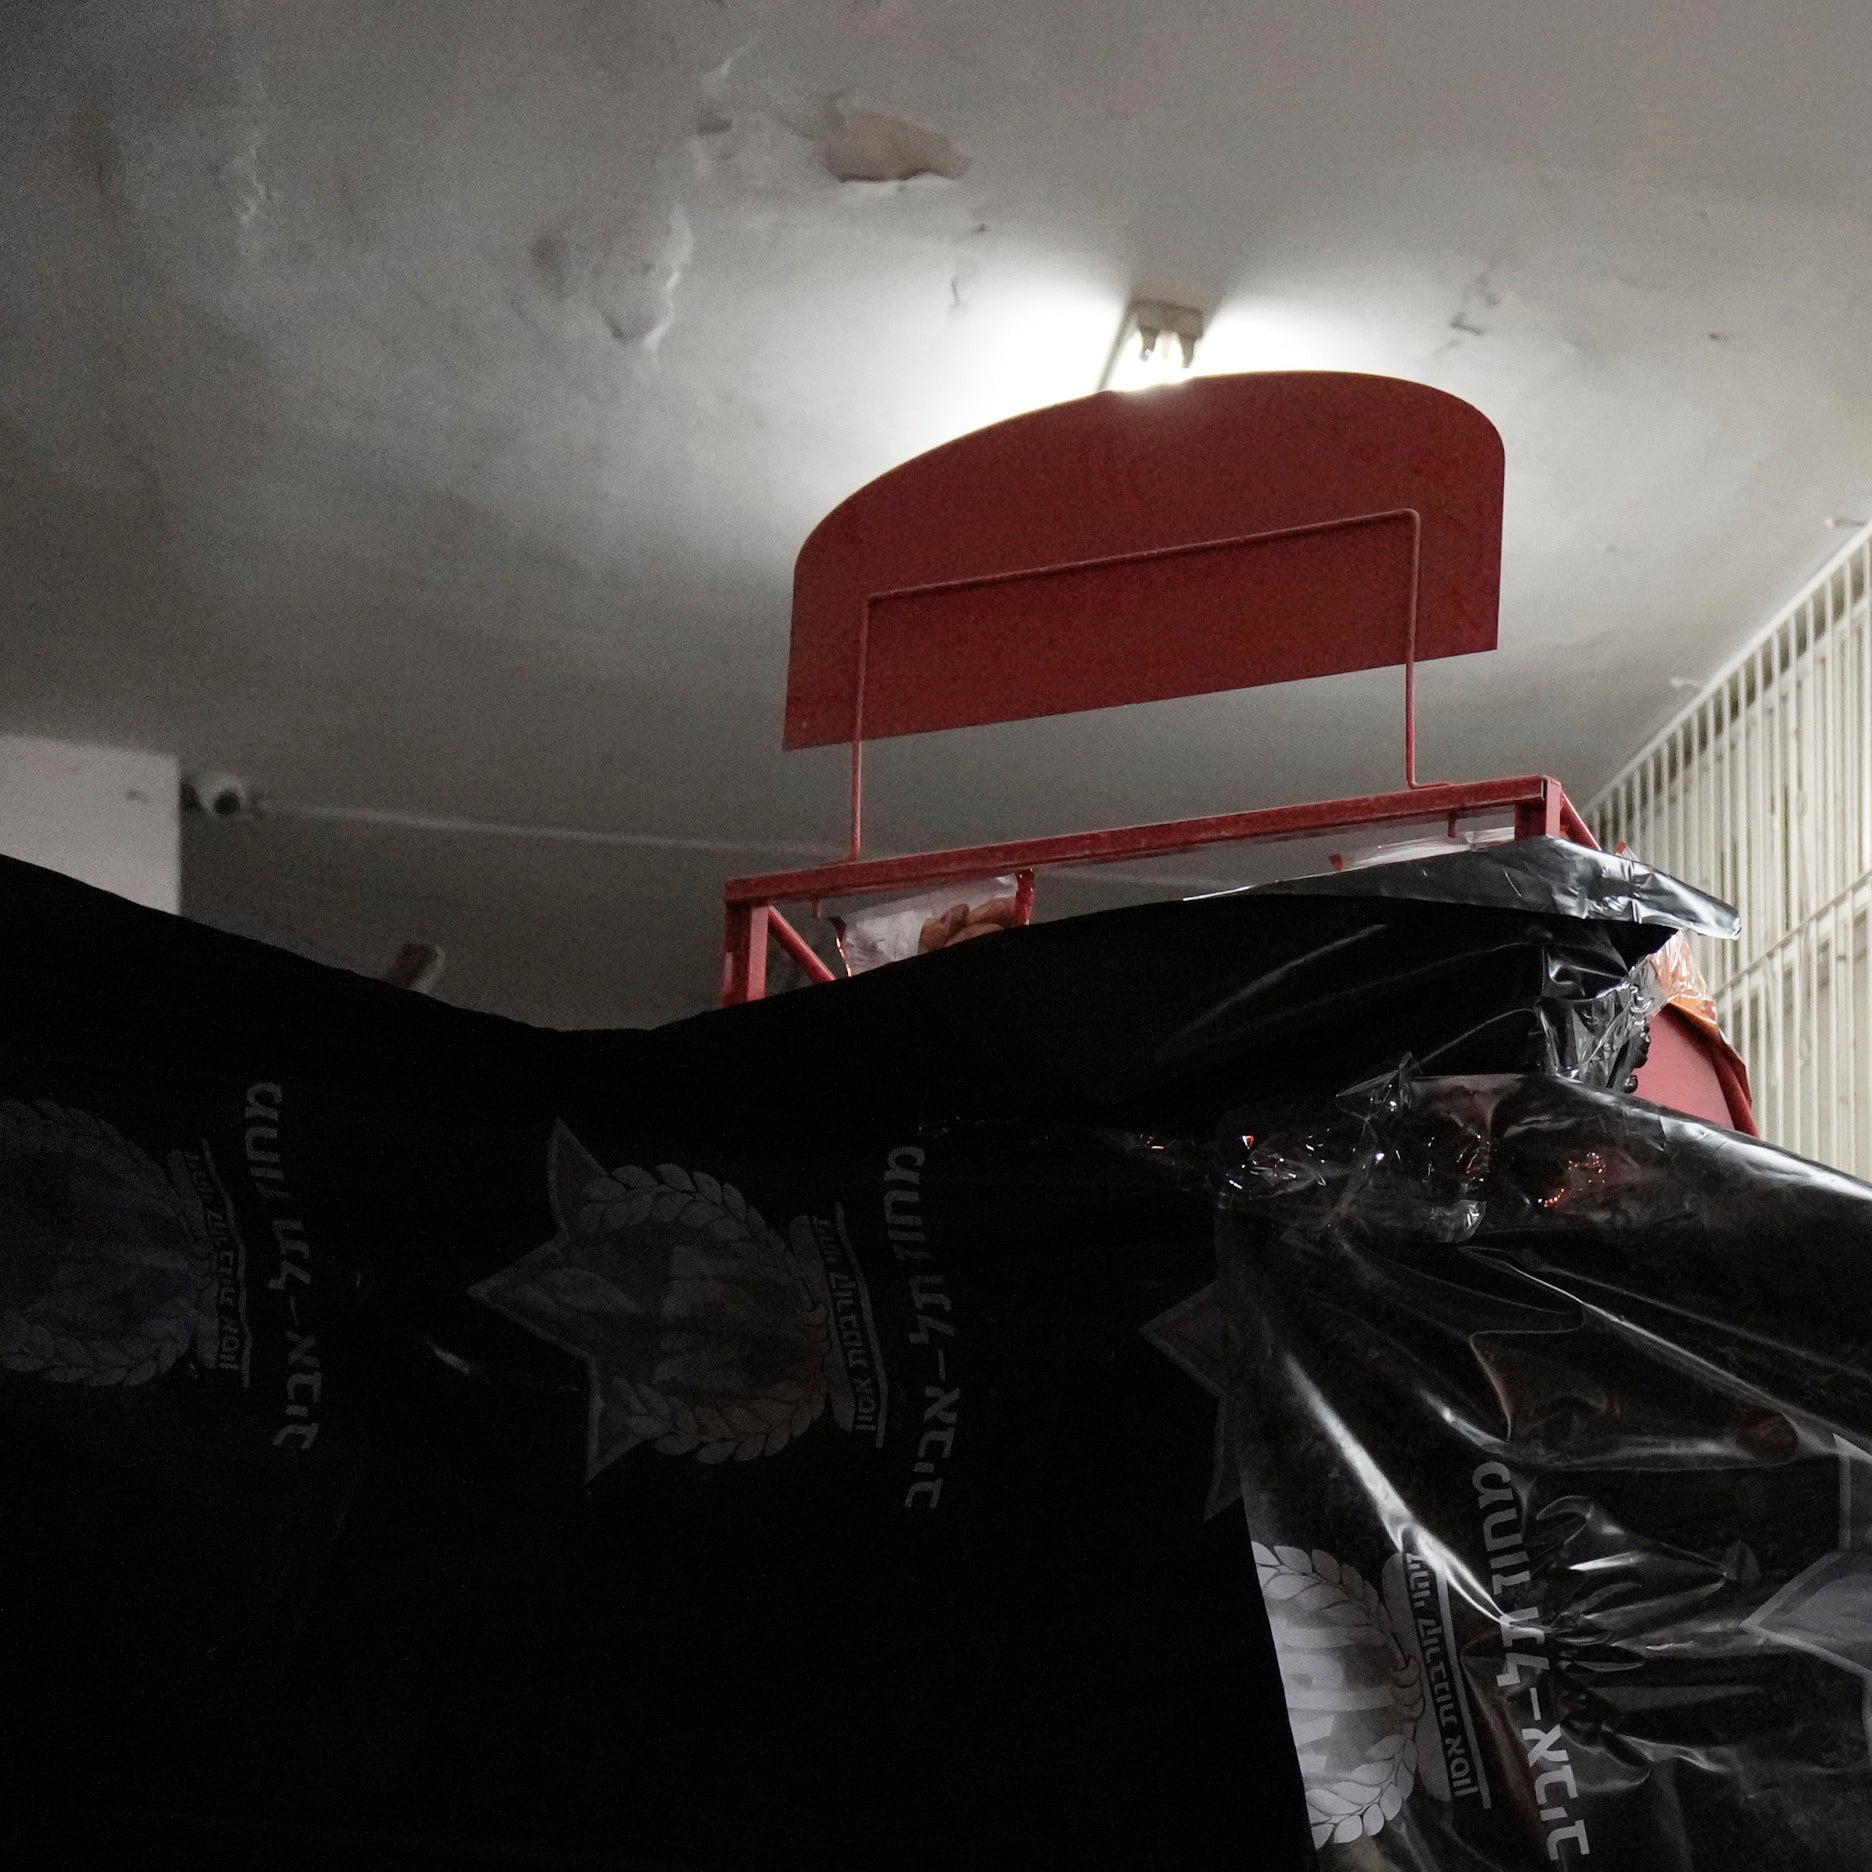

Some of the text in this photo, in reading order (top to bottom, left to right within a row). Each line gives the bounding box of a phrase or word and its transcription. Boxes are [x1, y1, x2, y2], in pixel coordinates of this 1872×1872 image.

[244, 1080, 323, 1451] מחוז תל-אביב
[852, 1374, 878, 1433] אסון
[882, 1144, 961, 1510] מחוז תל-אביב
[1415, 1616, 1459, 1726] קורבנות
[1446, 1734, 1479, 1798] אסון
[1471, 1460, 1591, 1862] מחוז תל-אביב
